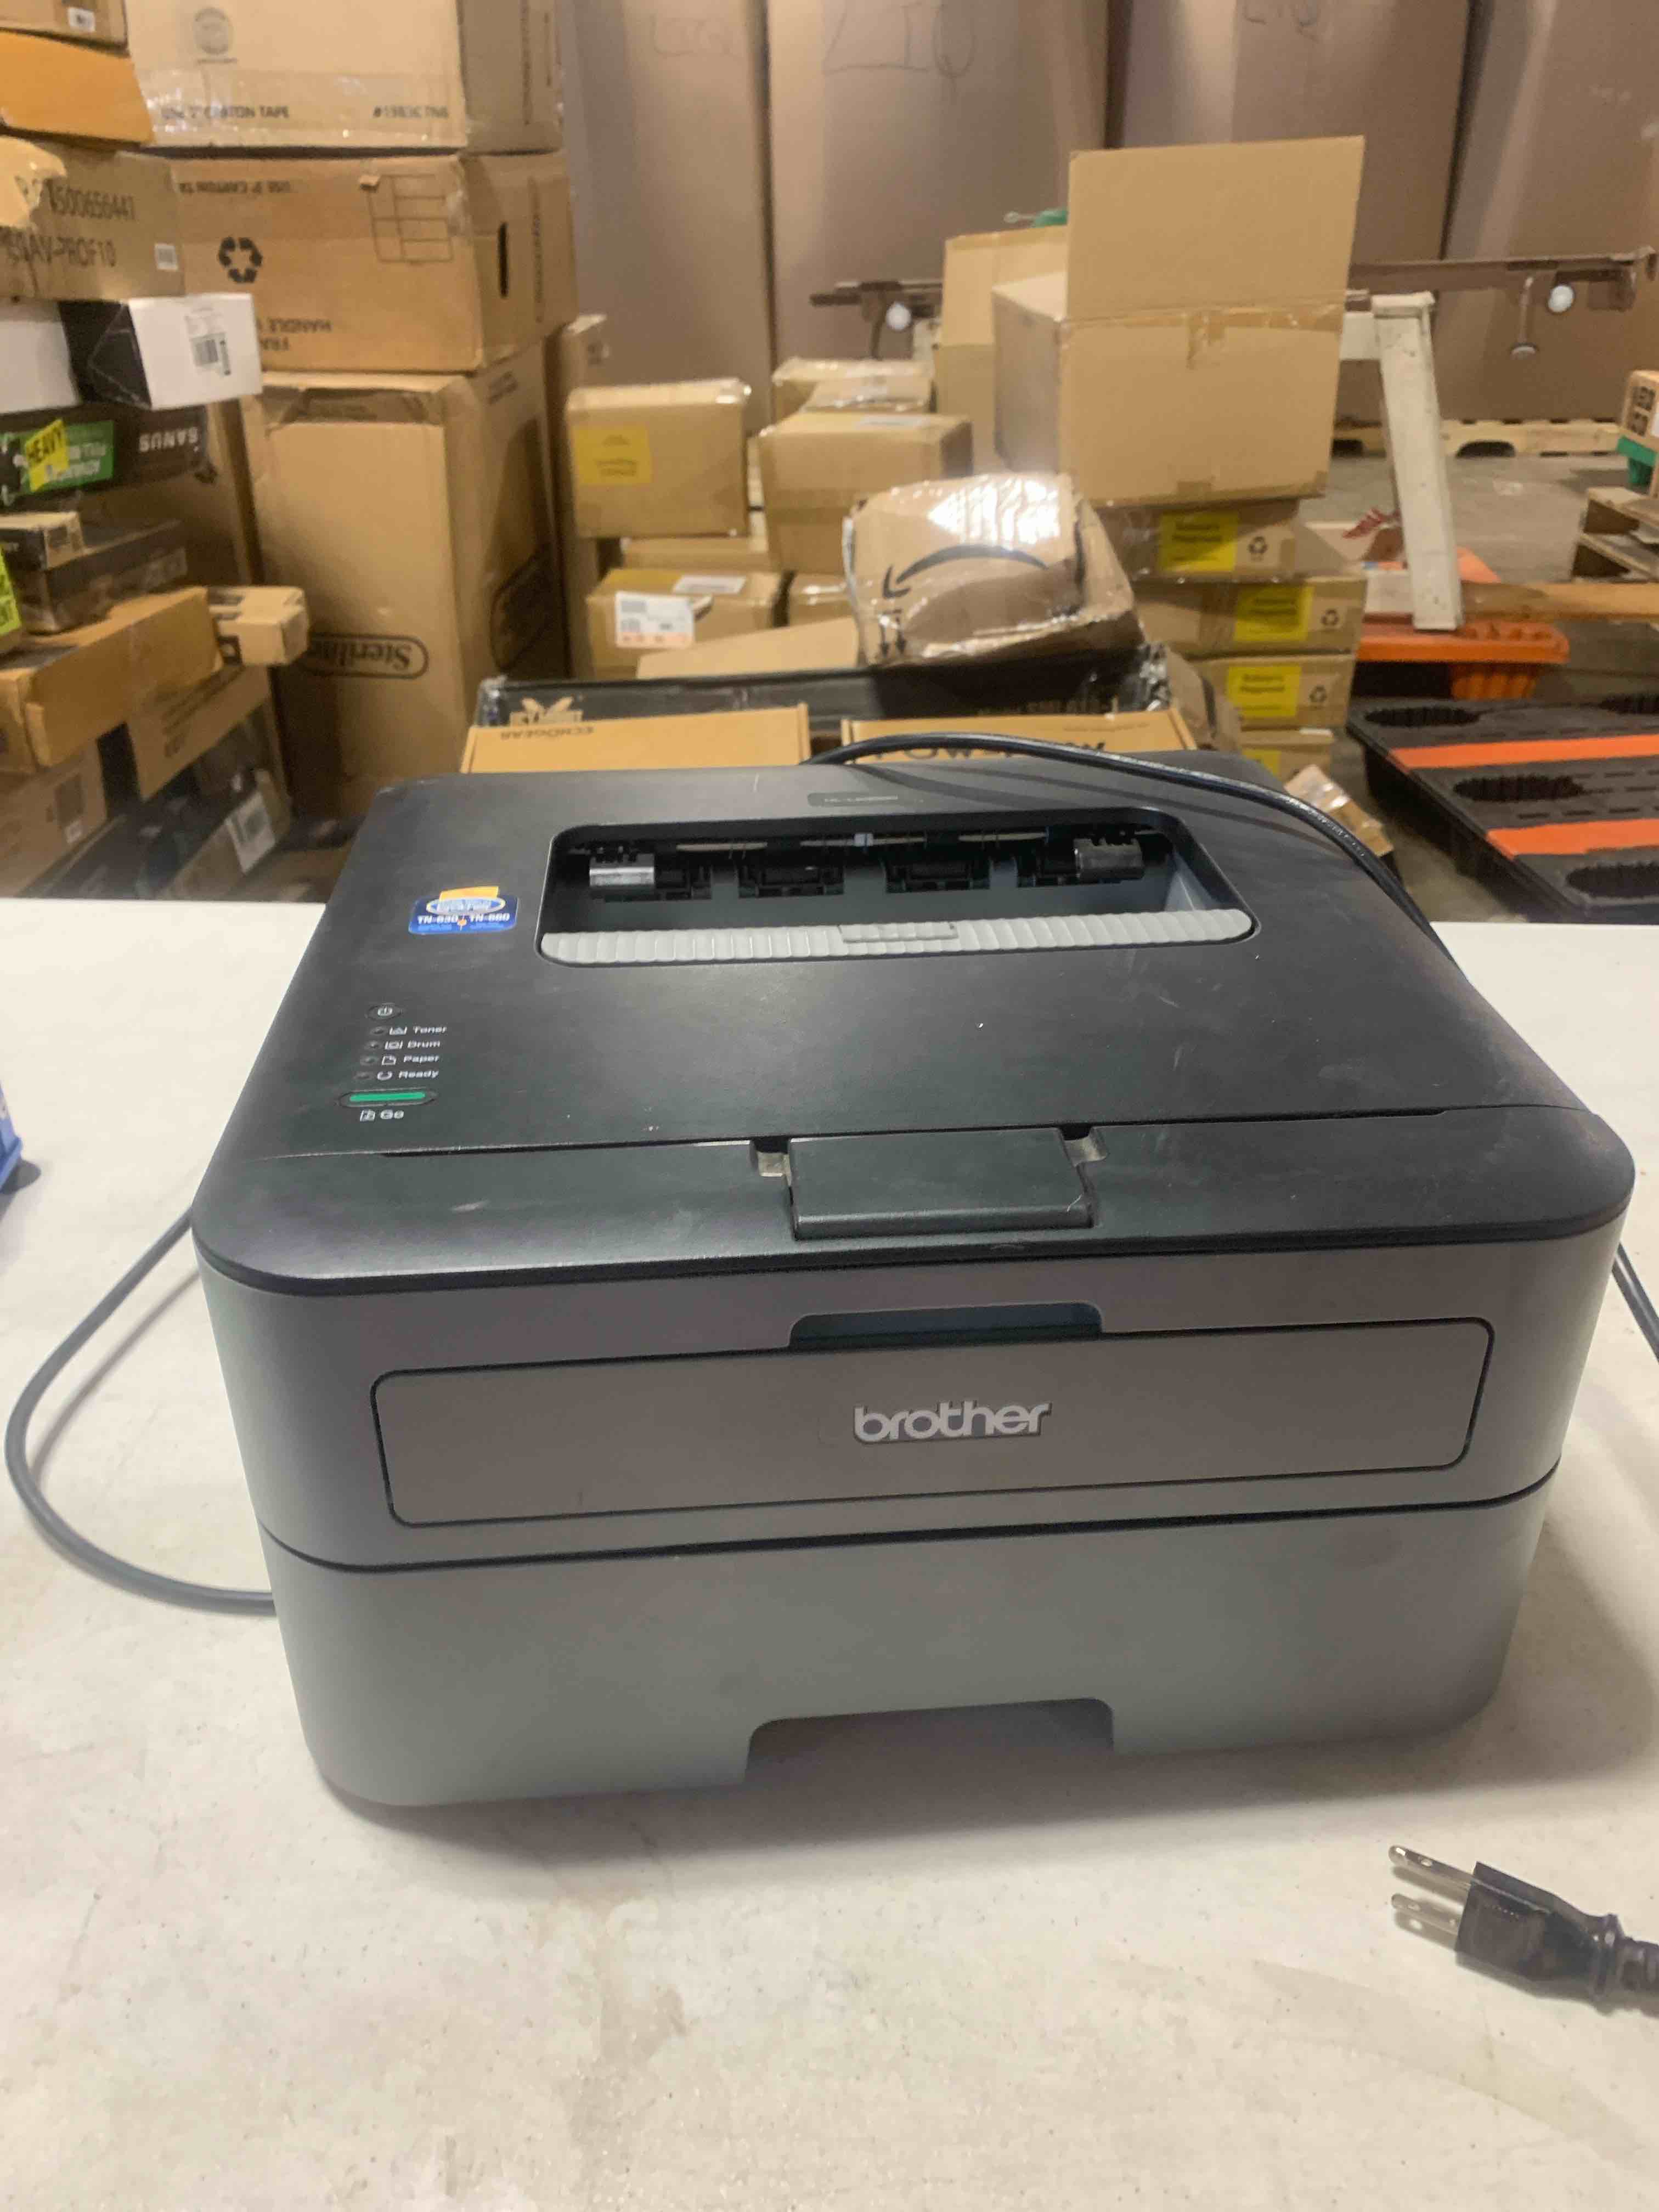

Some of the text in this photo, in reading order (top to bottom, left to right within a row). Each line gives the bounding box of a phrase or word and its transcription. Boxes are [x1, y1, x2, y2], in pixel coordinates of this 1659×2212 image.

[259, 106, 289, 119] TAPE
[413, 1025, 448, 1035] Toner
[407, 1040, 441, 1049] Drum
[403, 1055, 439, 1064] Paper
[398, 1069, 439, 1079] Ready
[380, 1110, 404, 1120] Go
[854, 1400, 1052, 1444] brother
